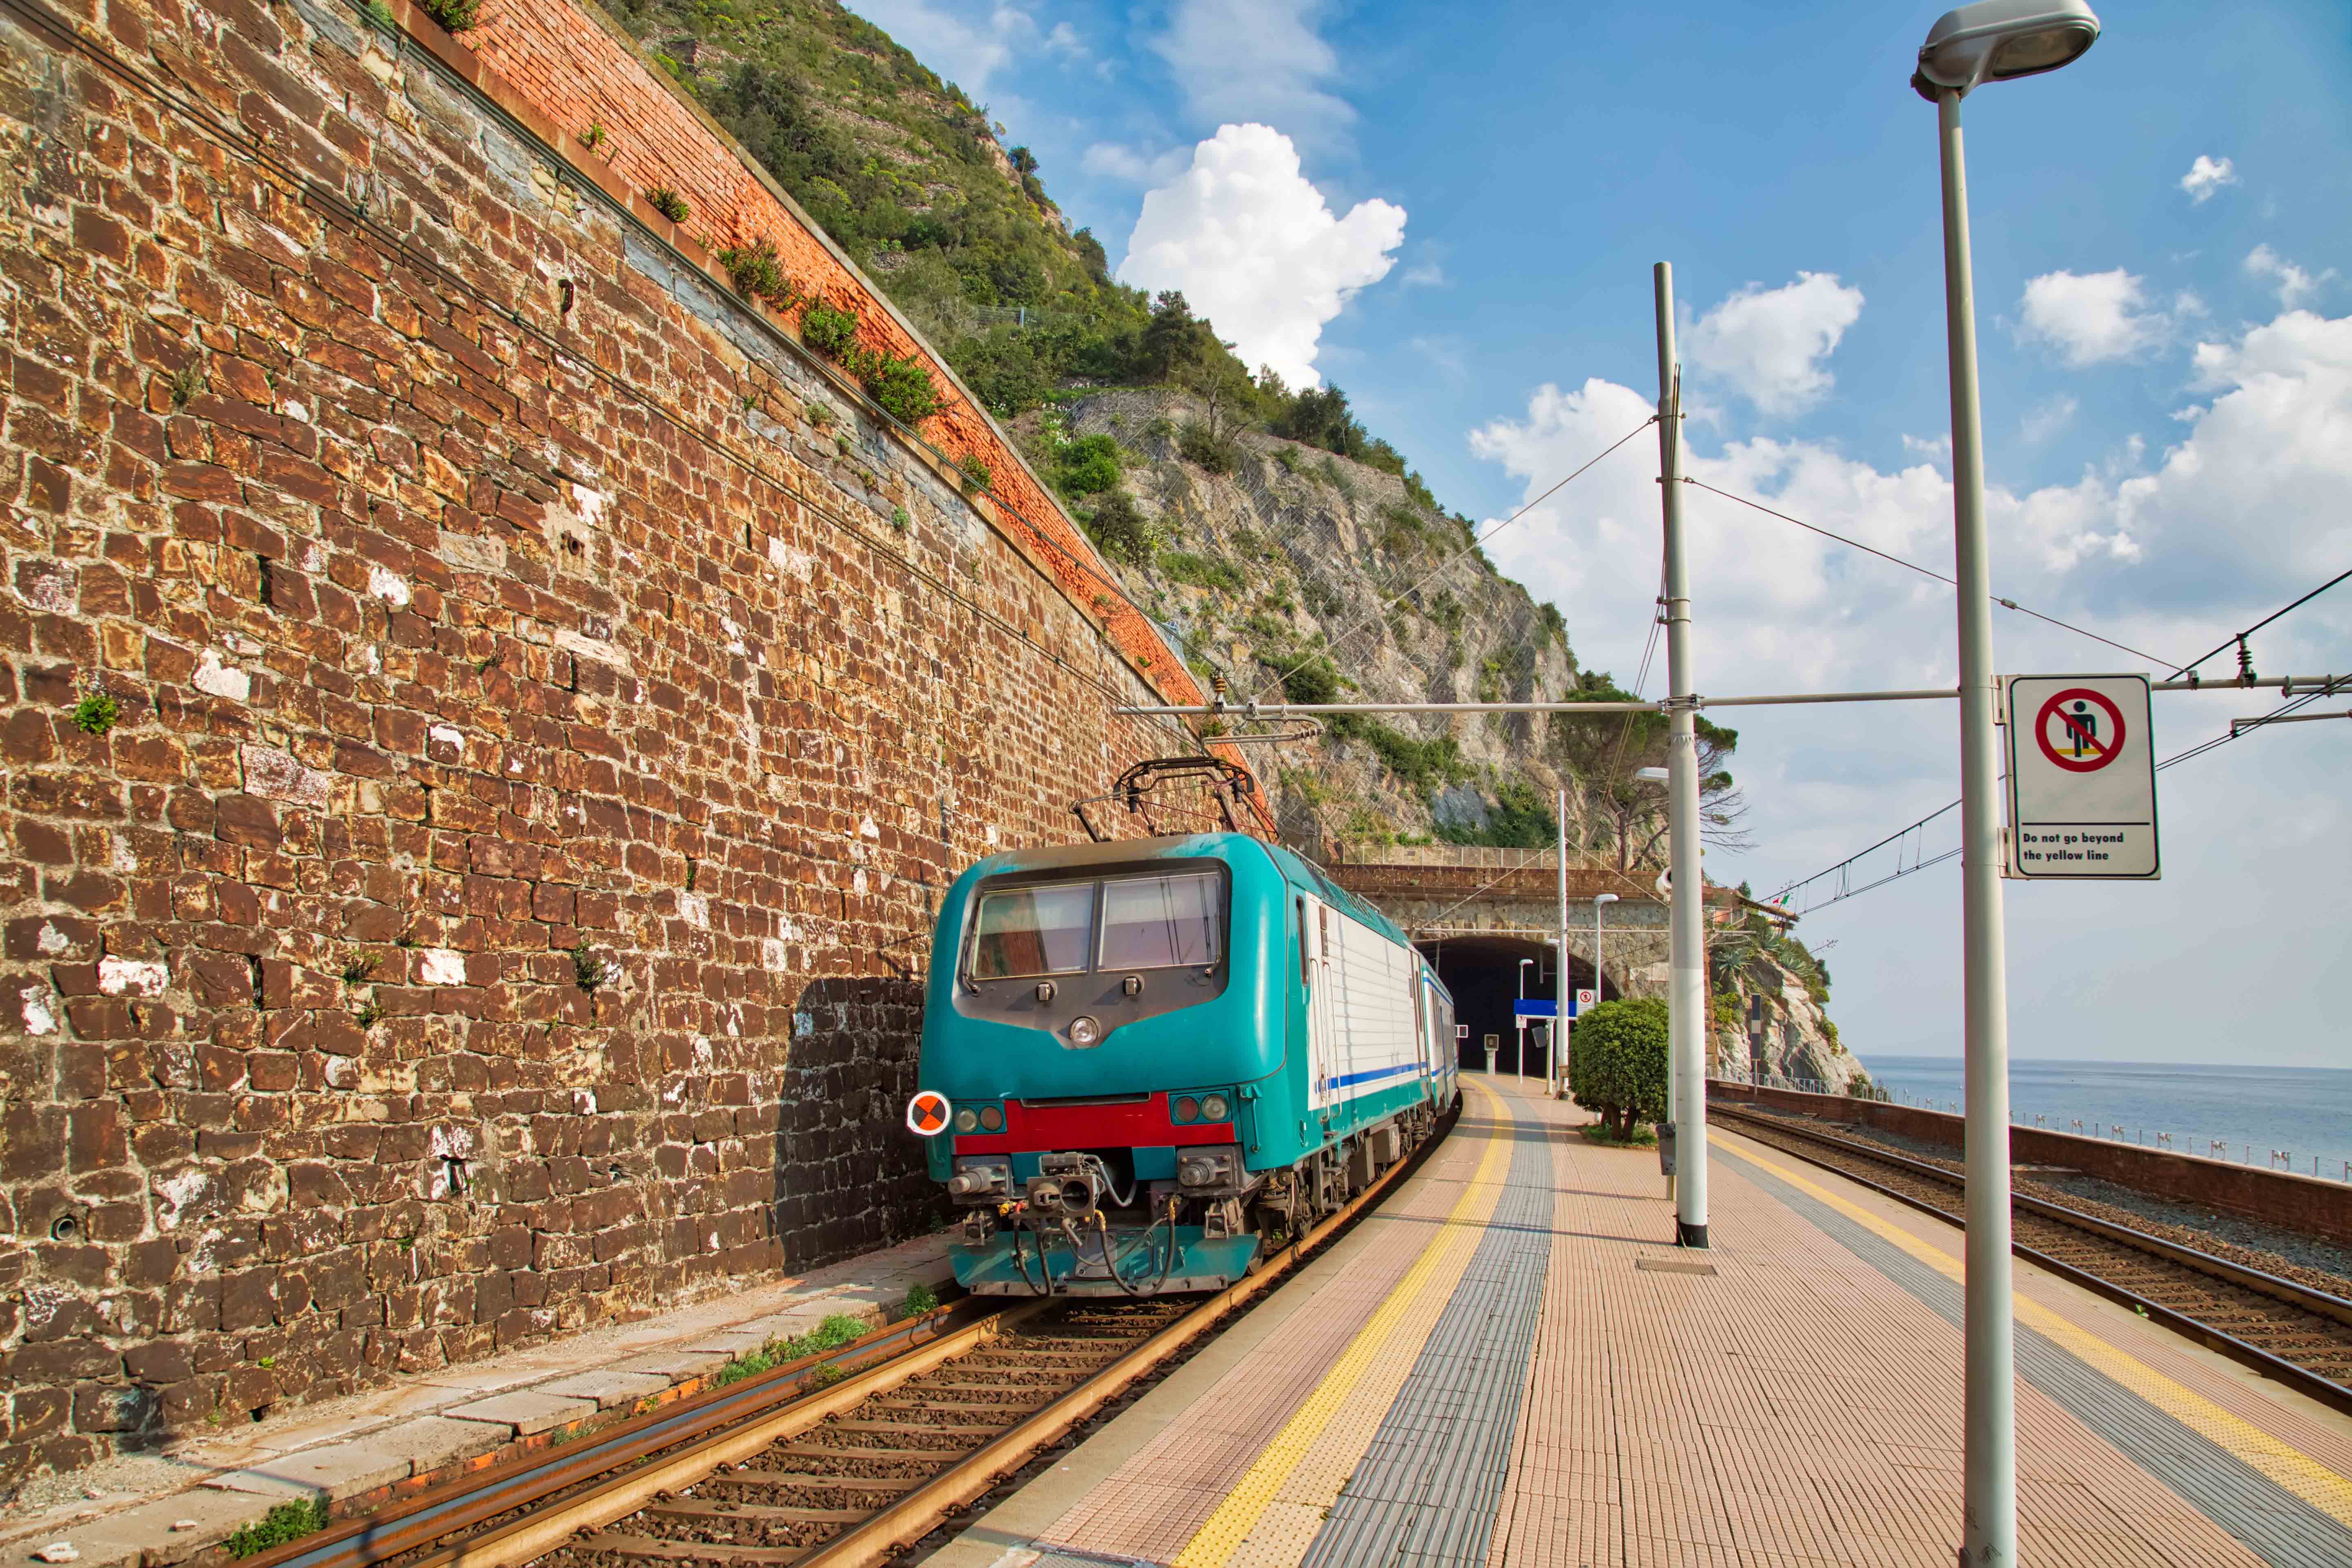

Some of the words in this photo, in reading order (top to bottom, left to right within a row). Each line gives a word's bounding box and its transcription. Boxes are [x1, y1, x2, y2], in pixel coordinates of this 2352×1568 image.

[2023, 833, 2038, 842] Do
[2042, 834, 2060, 842] not
[2064, 835, 2078, 844] go
[2082, 832, 2124, 844] beyond
[2024, 850, 2041, 860] the
[2046, 850, 2083, 862] yellow
[2087, 850, 2109, 860] line
